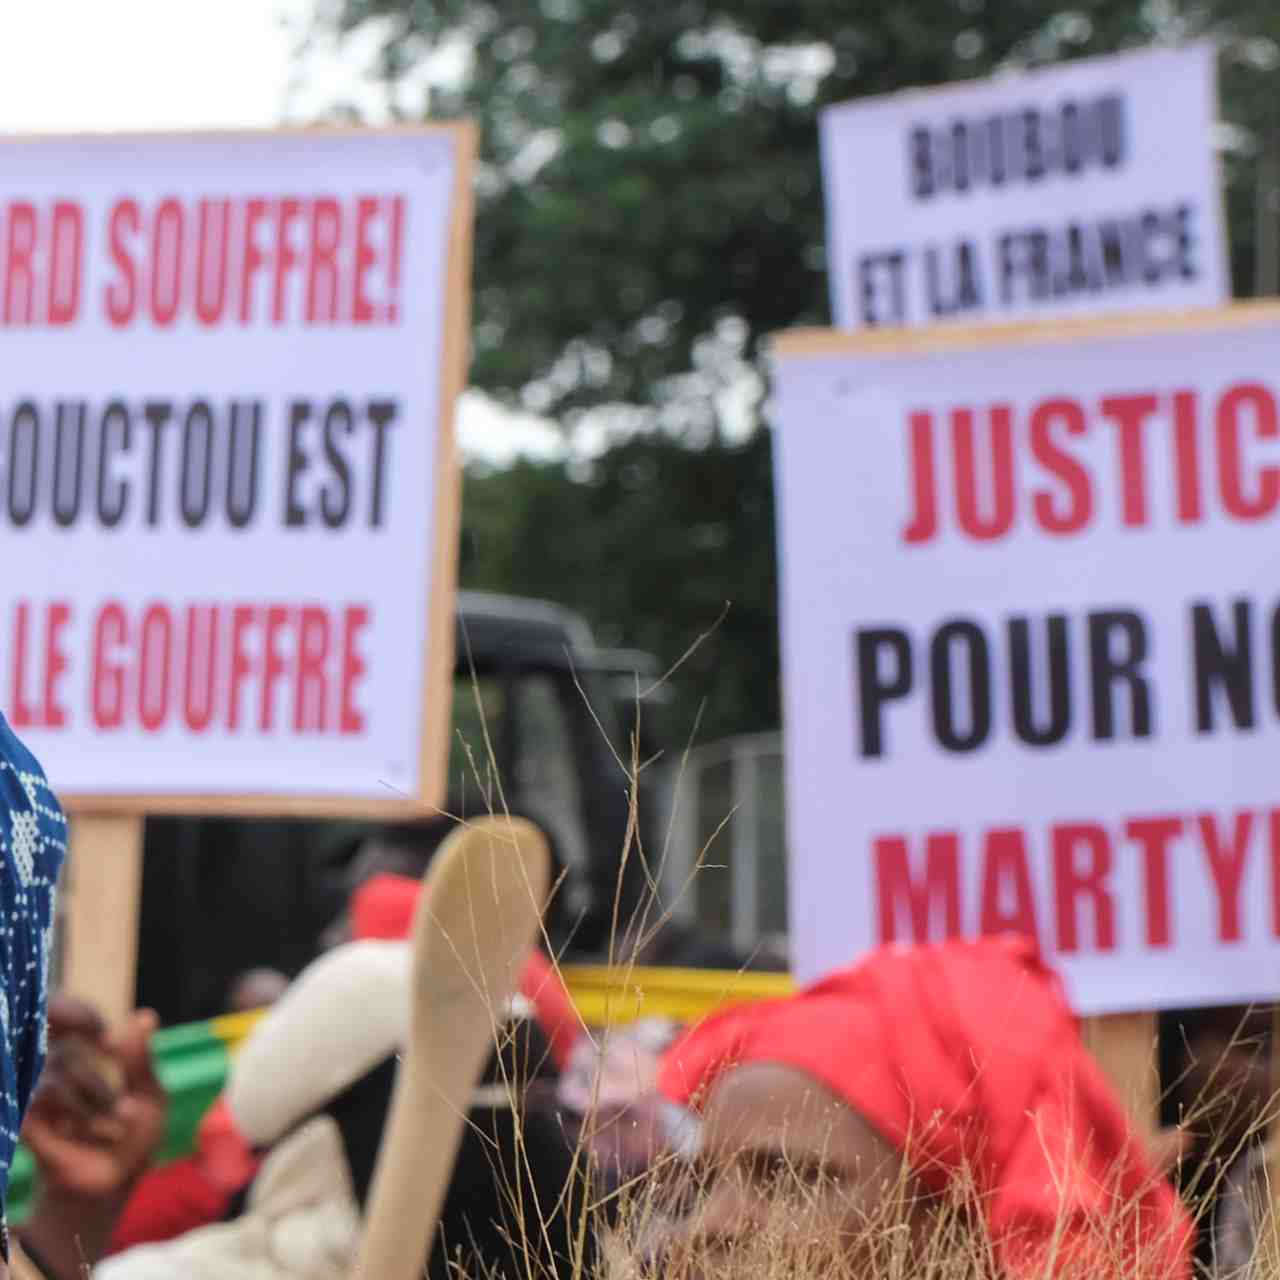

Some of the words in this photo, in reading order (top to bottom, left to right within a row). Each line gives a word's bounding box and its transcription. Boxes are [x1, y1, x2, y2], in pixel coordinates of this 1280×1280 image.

[910, 94, 1124, 198] BOUBOU
[104, 194, 407, 328] SOUFFRE!
[857, 250, 905, 326] ET
[924, 239, 981, 316] LA
[999, 204, 1196, 303] FRANCE
[282, 397, 399, 528] EST
[11, 600, 72, 731] LE
[90, 600, 368, 734] GOUFFRE
[854, 609, 1153, 760] POUR
[1190, 595, 1280, 738] N
[872, 809, 1280, 955] MARTY
